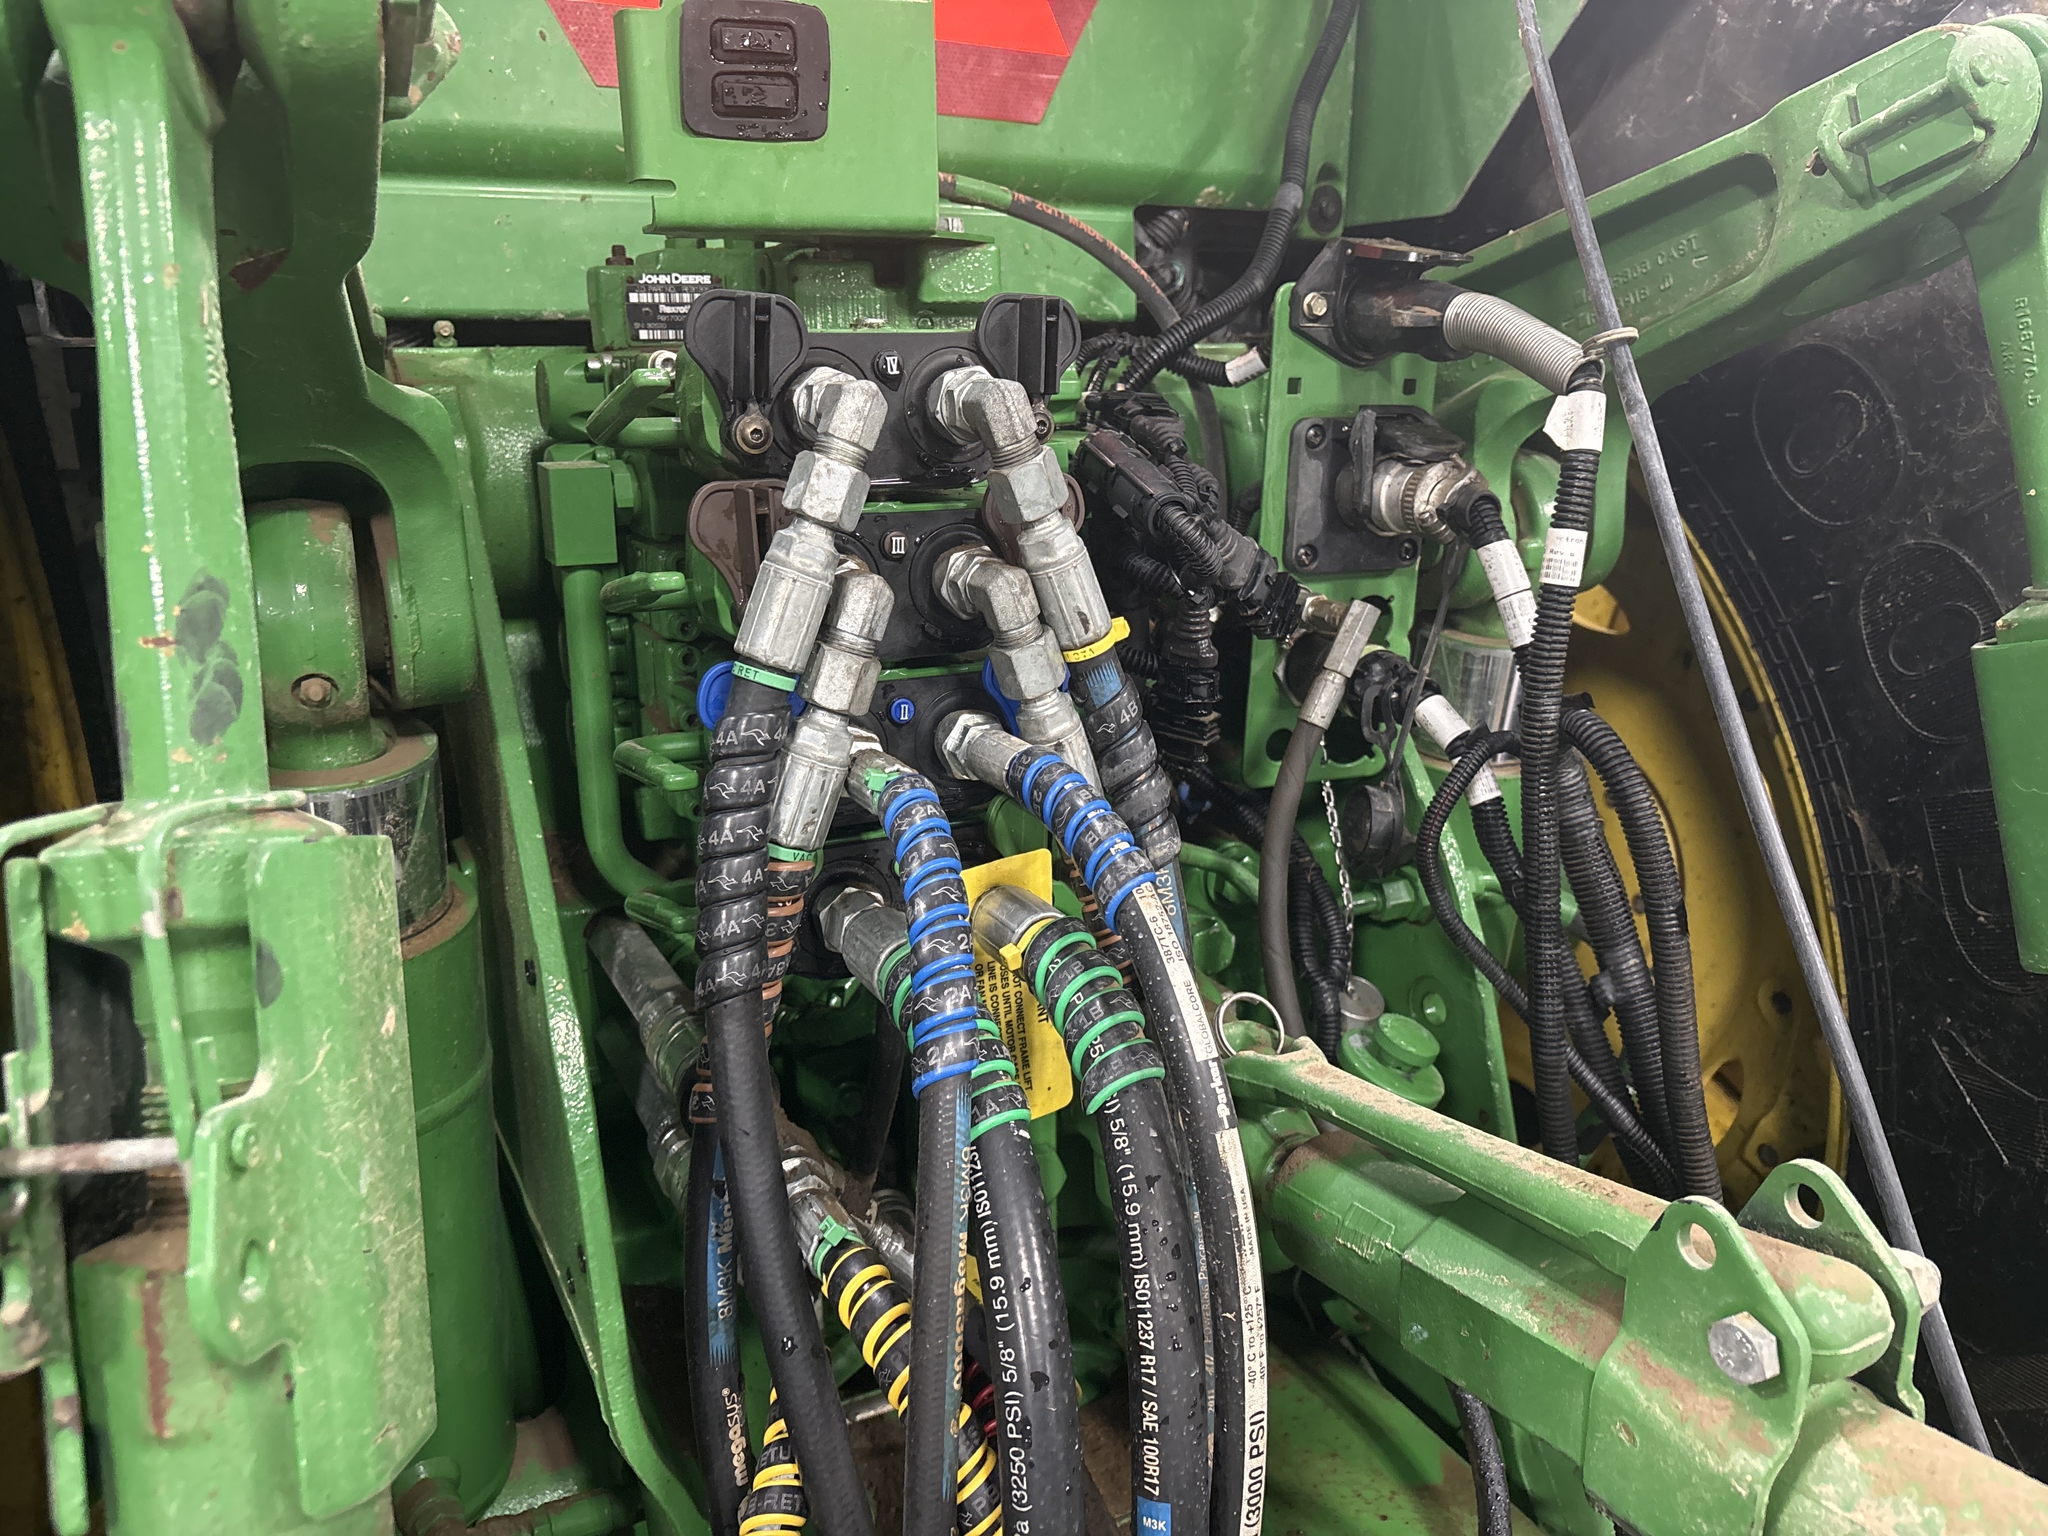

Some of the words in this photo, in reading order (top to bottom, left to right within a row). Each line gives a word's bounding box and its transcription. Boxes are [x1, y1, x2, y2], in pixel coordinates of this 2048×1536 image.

[1068, 215, 1105, 243] MADE
[1657, 233, 1699, 266] CAST
[638, 273, 671, 284] JOHN
[671, 272, 711, 284] DEERE
[885, 355, 900, 375] IV
[891, 536, 906, 555] III
[737, 664, 760, 681] RET
[900, 704, 909, 720] II
[1120, 701, 1139, 725] 4B
[716, 730, 739, 746] 4A
[740, 779, 766, 795] 4A
[708, 829, 735, 846] 4A
[741, 867, 764, 885] 4A
[713, 919, 741, 939] 4A
[1149, 915, 1176, 965] 387TC-6
[1171, 939, 1185, 962] ISO
[974, 963, 984, 977] OR
[987, 961, 997, 984] LINE
[999, 964, 1010, 989] OSES
[697, 978, 717, 998] 4A
[1002, 990, 1012, 1020] UNTIL
[1014, 990, 1026, 1035] CONNECT
[1004, 1020, 1017, 1053] MOTOR
[926, 1042, 958, 1067] 2A
[1018, 1036, 1030, 1070] FRAME
[1023, 1071, 1034, 1092] LIFT
[1207, 1060, 1230, 1130] Parker
[971, 1098, 1000, 1124] 1A
[1116, 1163, 1141, 1217] (15.9
[980, 1220, 1001, 1270] mm)
[1127, 1222, 1149, 1270] mm)
[717, 1258, 733, 1320] 8M3K
[990, 1276, 1016, 1332] (15.9
[997, 1340, 1018, 1383] 5/8"
[1140, 1355, 1157, 1387] R17
[1003, 1390, 1024, 1439] PSI)
[1141, 1400, 1159, 1433] SAE
[1249, 1409, 1266, 1461] PSI)
[1009, 1446, 1033, 1512] (3250
[1143, 1437, 1160, 1497] 100R17
[1244, 1465, 1264, 1529] (3000
[1141, 1515, 1168, 1533] M3K
